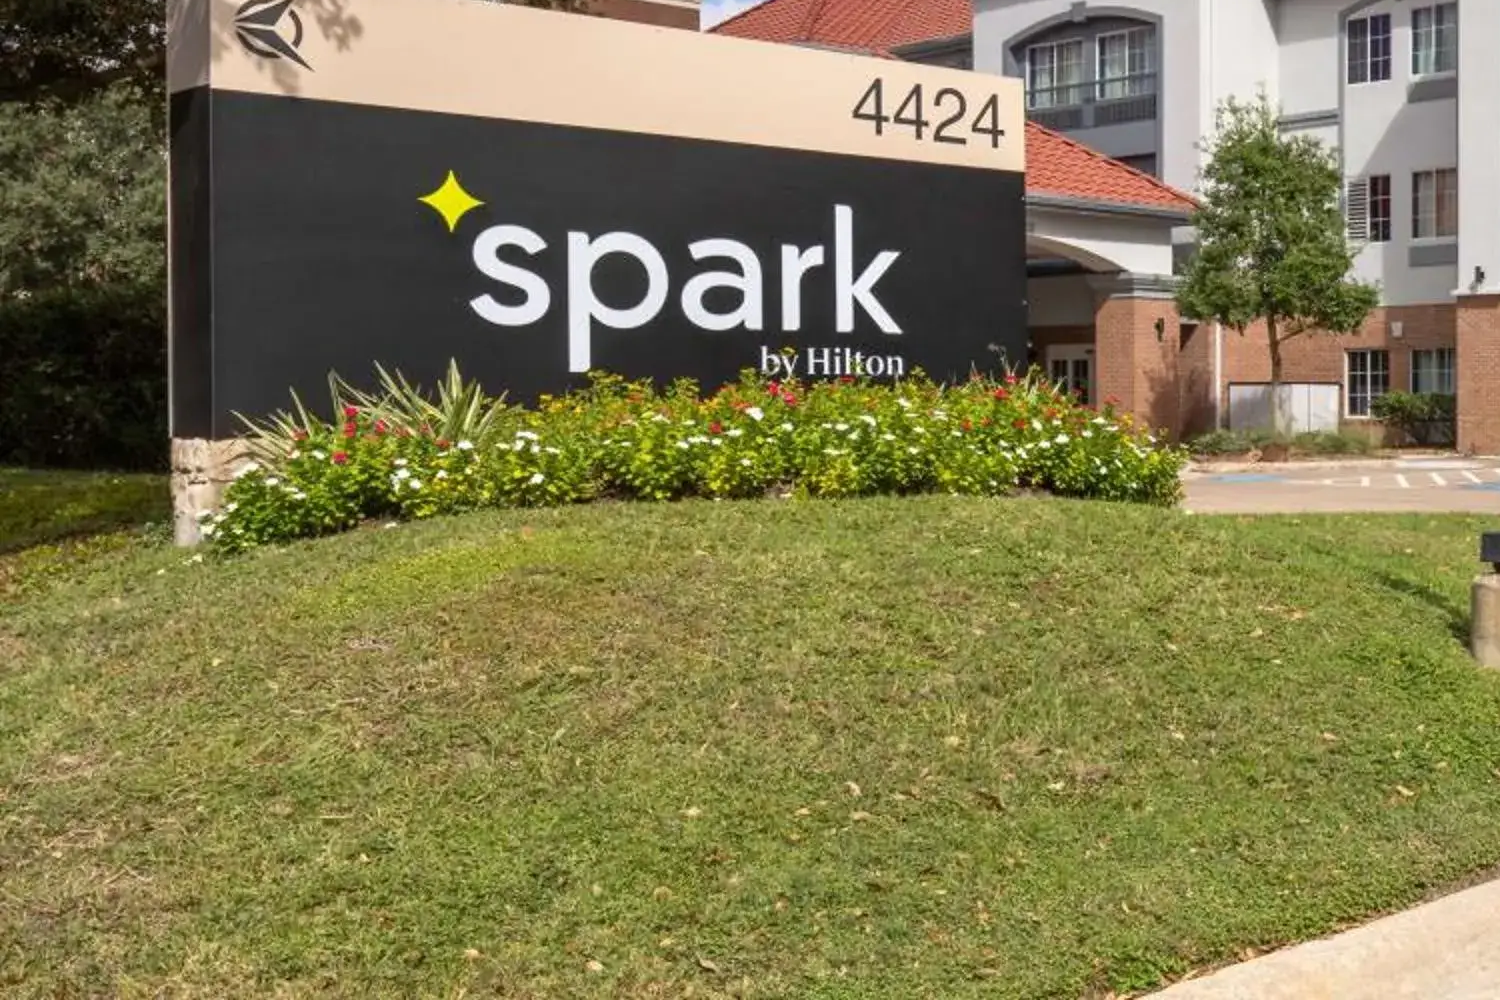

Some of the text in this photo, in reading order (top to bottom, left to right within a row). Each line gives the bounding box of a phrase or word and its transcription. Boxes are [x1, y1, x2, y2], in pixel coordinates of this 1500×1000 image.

[852, 78, 1005, 148] 4424
[470, 204, 904, 372] spark
[760, 346, 904, 381] by Hilton
